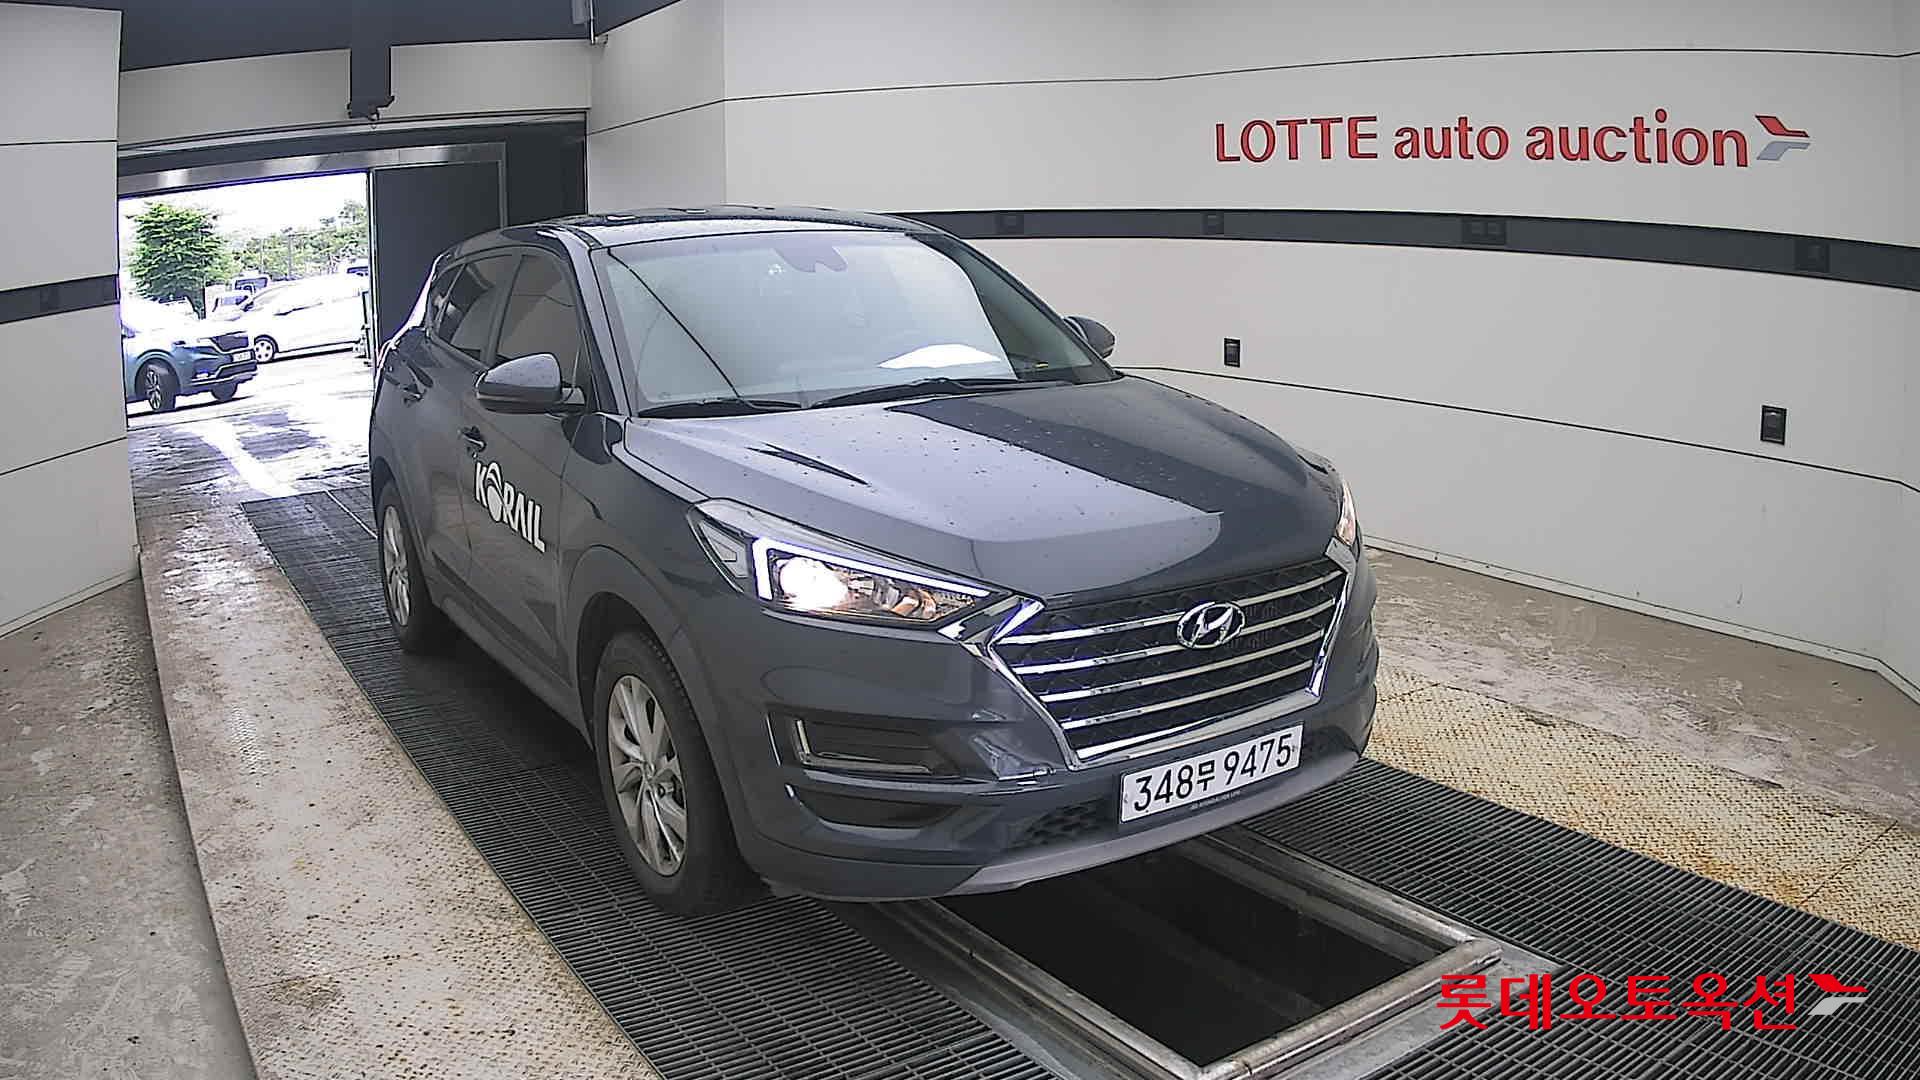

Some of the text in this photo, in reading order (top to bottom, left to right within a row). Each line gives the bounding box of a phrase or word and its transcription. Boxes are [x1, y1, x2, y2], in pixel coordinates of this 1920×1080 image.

[1215, 108, 1748, 168] LOTTE auto auction
[475, 461, 546, 553] KORAIL
[1133, 733, 1292, 812] 348무 9475
